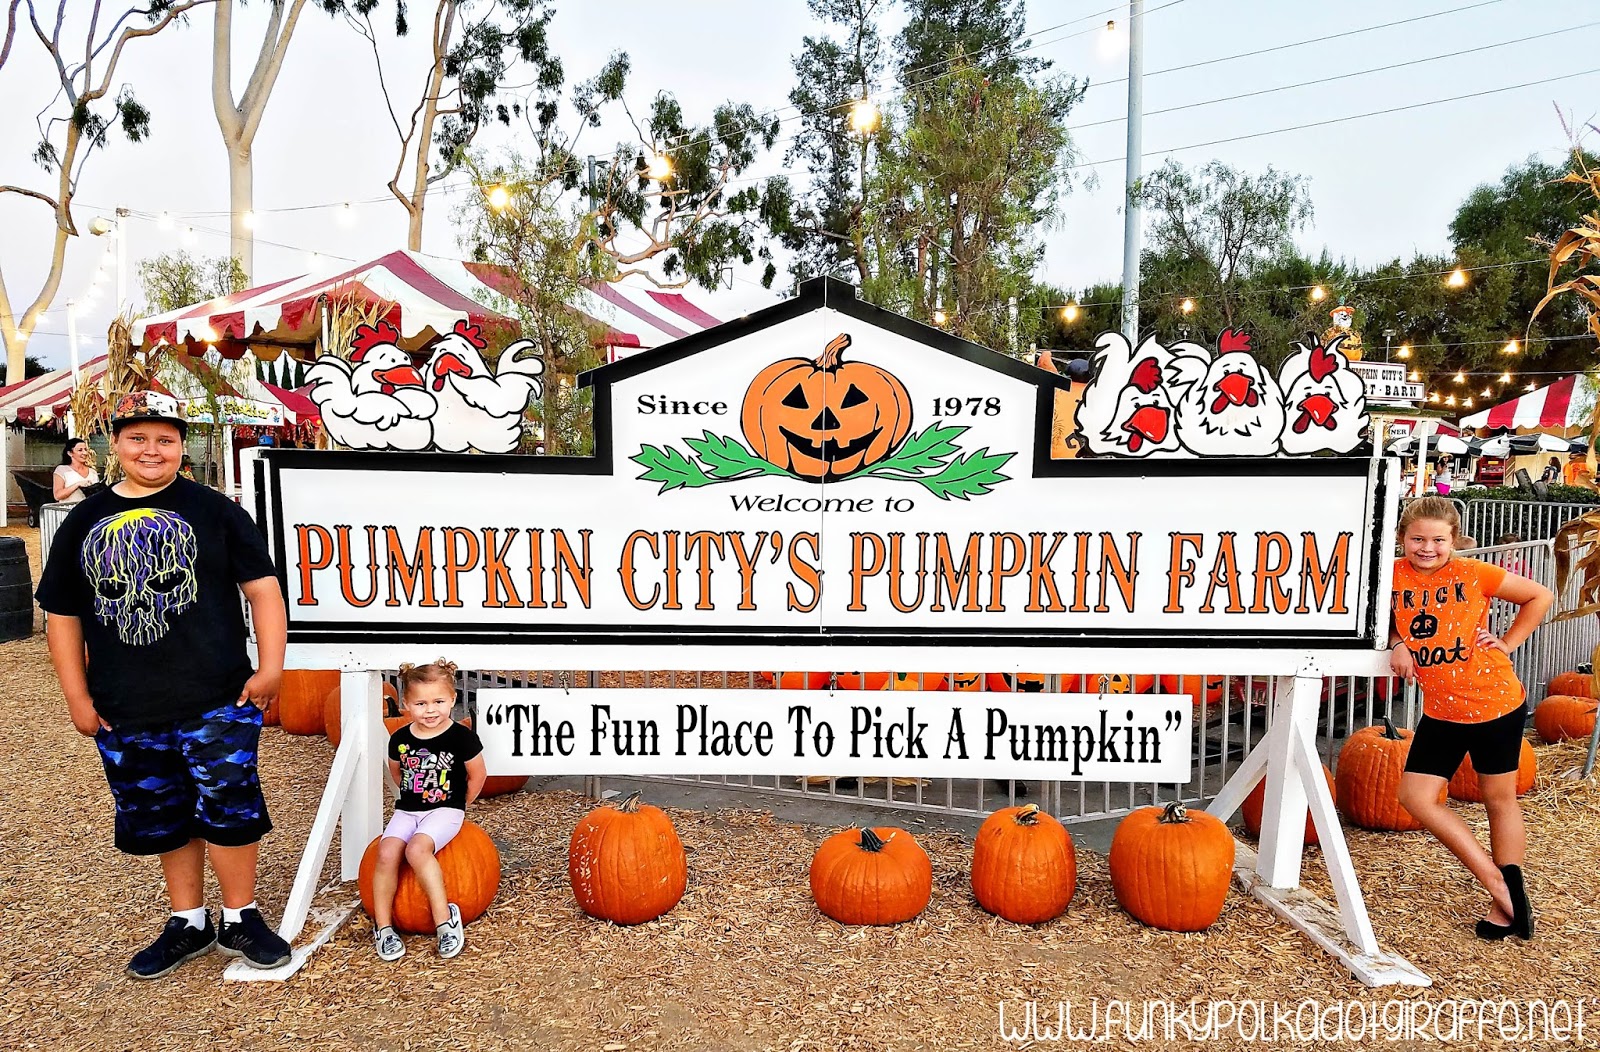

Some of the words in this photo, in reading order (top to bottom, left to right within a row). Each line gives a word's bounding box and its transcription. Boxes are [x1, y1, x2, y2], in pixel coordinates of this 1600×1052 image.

[1352, 367, 1378, 380] MPKIN
[1381, 369, 1403, 381] CITY'S
[1385, 385, 1417, 397] BARN
[637, 394, 729, 416] Since
[931, 396, 1002, 418] 1978
[729, 493, 874, 513] Welcome
[885, 495, 916, 513] to
[293, 522, 595, 610] PUMPKIN
[616, 528, 825, 615] CITY'S
[845, 530, 1144, 615] PUMPKIN
[1161, 530, 1354, 615] FARM
[1390, 582, 1468, 610] TRICK
[1412, 618, 1433, 630] OR
[1407, 636, 1469, 668] reat
[589, 703, 661, 757] Fun
[674, 704, 775, 758] Place
[787, 705, 836, 758] To
[849, 706, 930, 760] Pick
[942, 706, 970, 760] A
